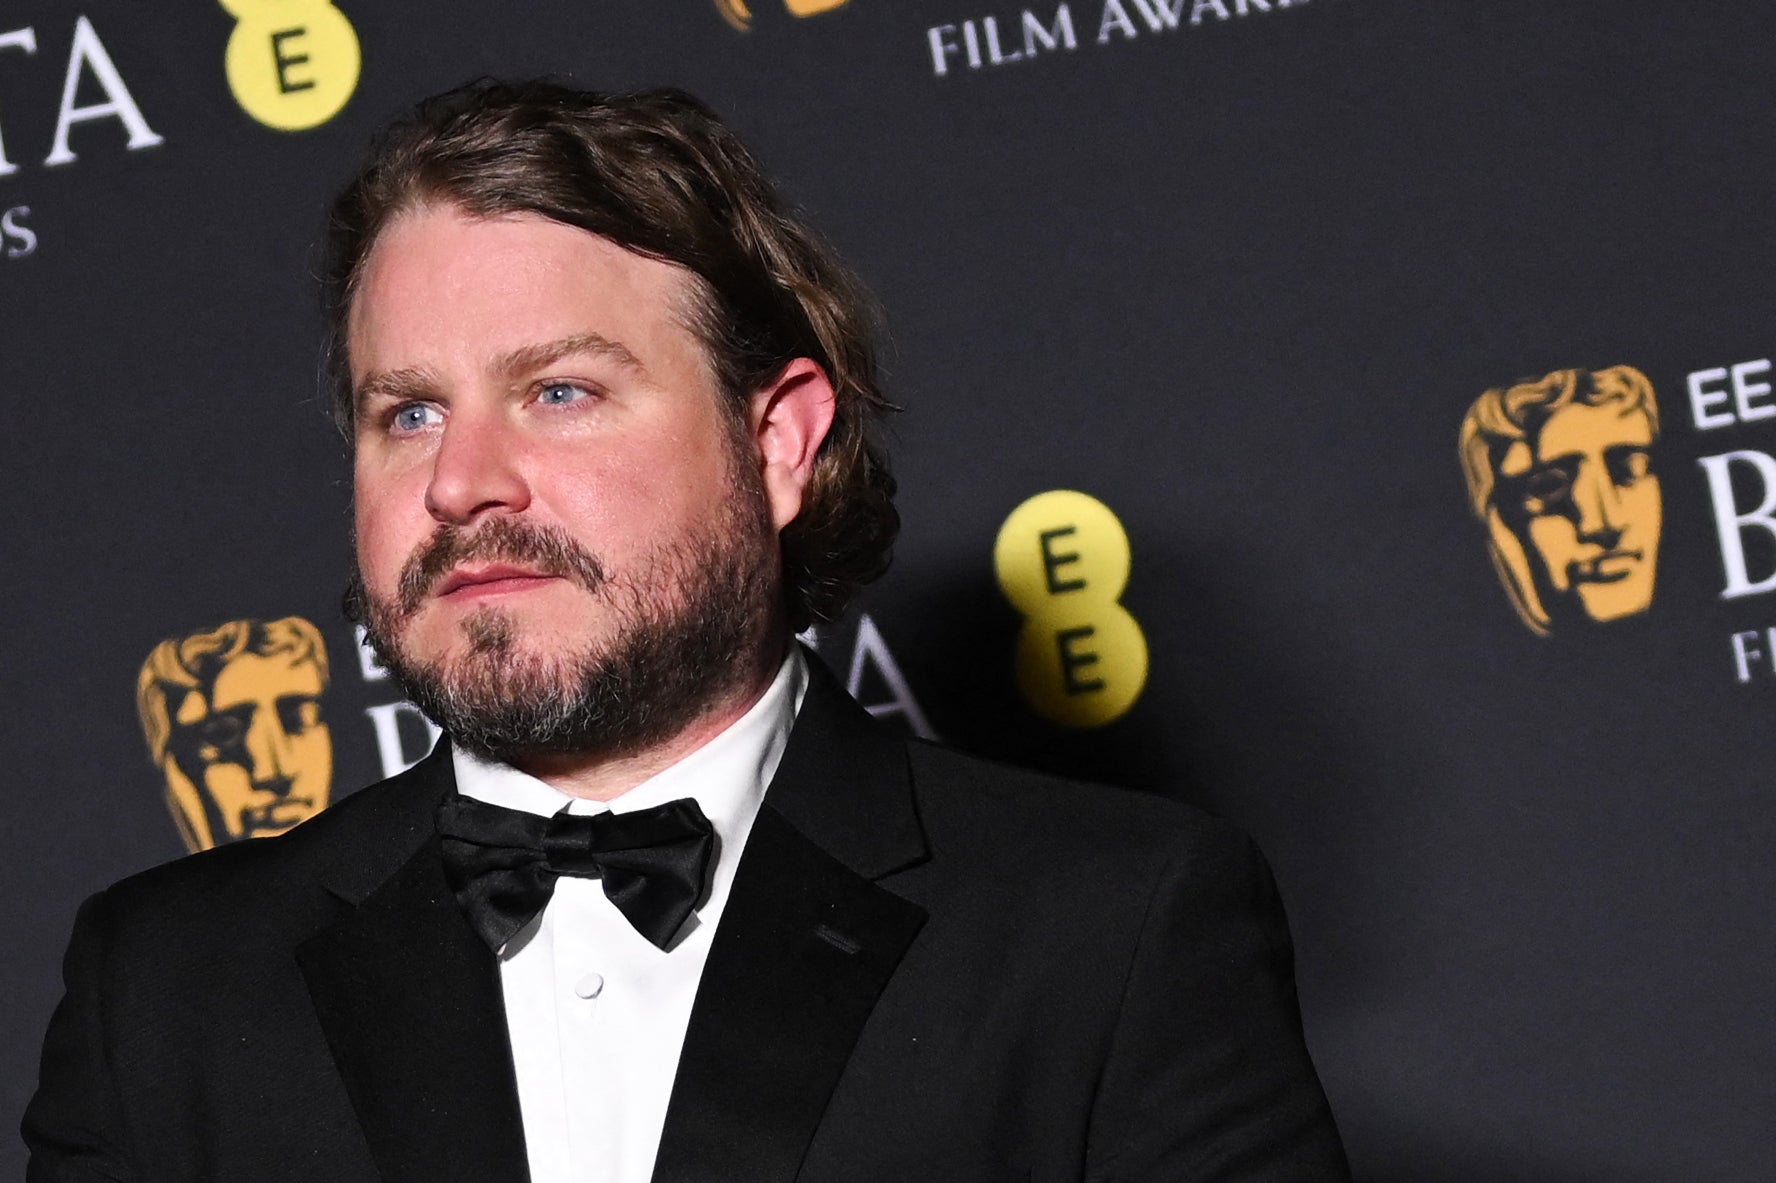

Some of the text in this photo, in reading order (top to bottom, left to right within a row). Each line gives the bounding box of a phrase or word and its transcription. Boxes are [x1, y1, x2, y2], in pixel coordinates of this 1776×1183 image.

[269, 26, 316, 95] E
[926, 0, 1310, 77] FILM AWA
[1684, 357, 1776, 432] EE
